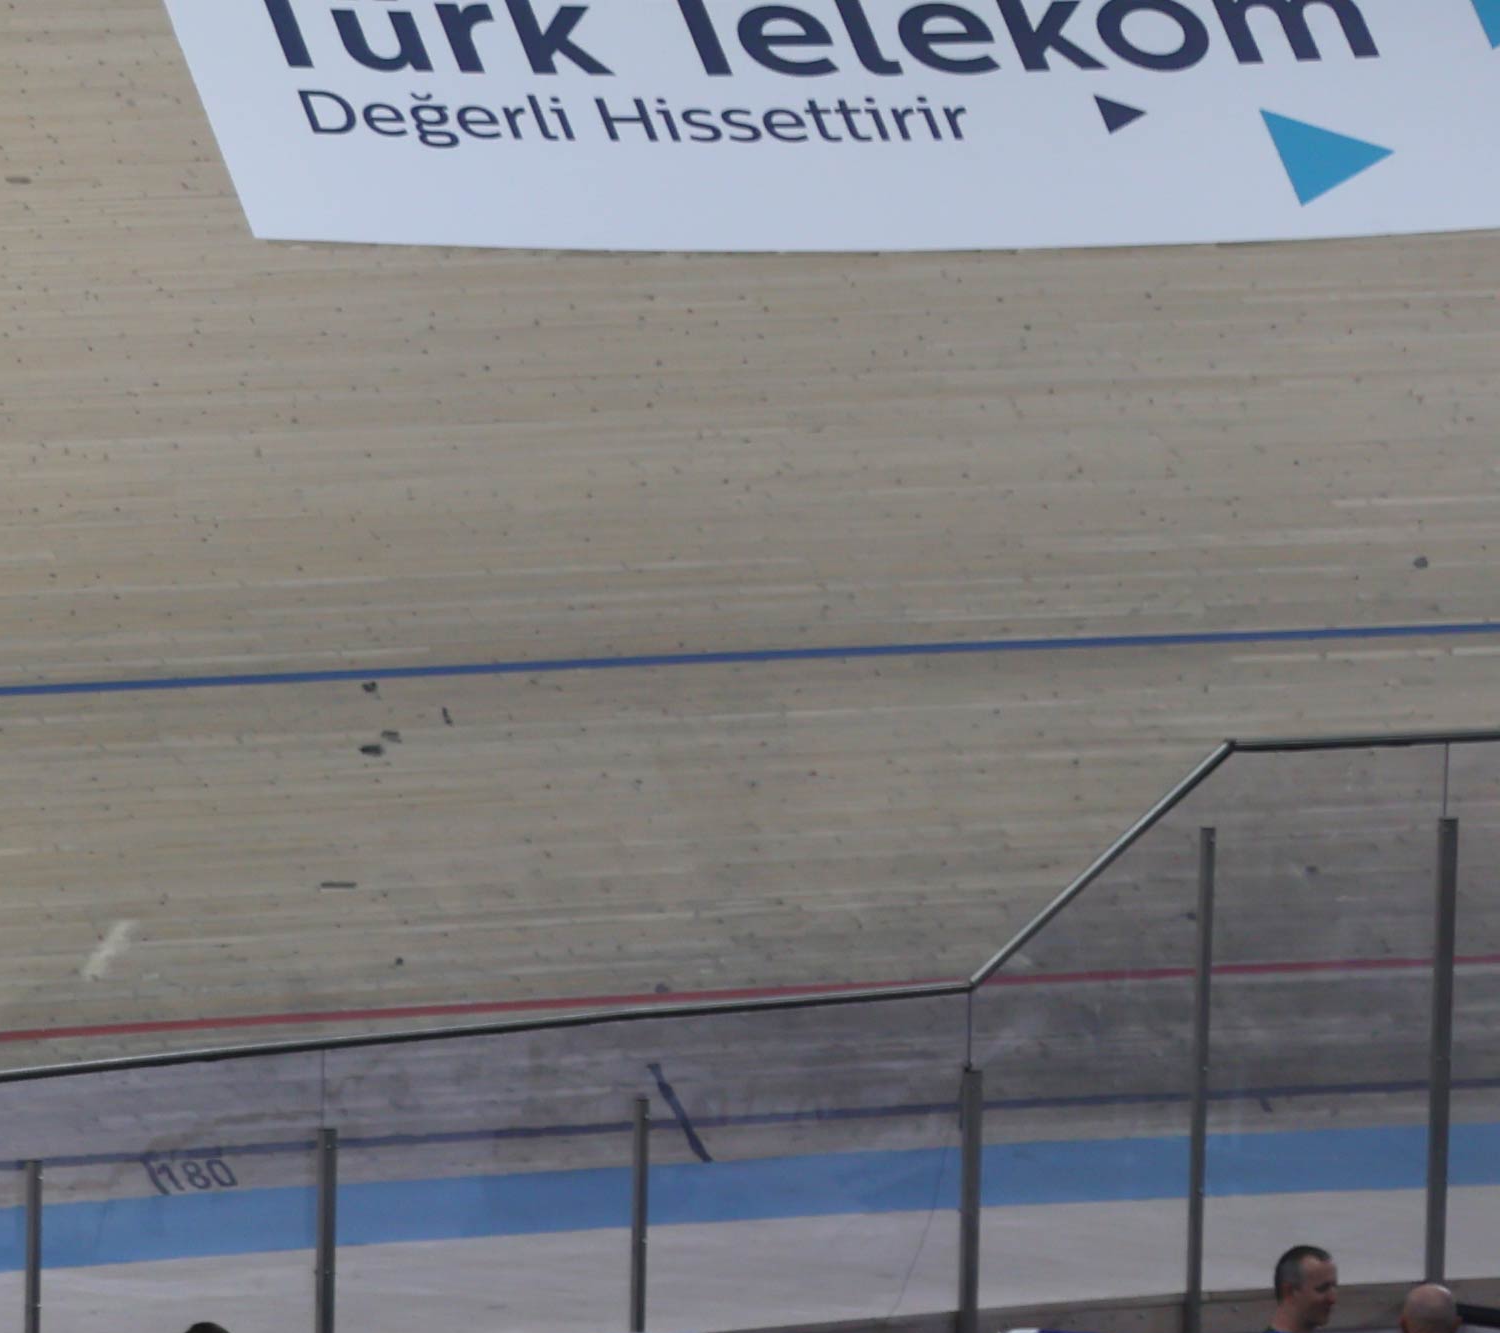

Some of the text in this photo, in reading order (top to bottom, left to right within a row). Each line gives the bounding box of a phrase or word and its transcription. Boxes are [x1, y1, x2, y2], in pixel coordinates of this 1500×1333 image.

[297, 89, 969, 148] Değerli Hissettirir
[156, 1158, 238, 1191] 180
